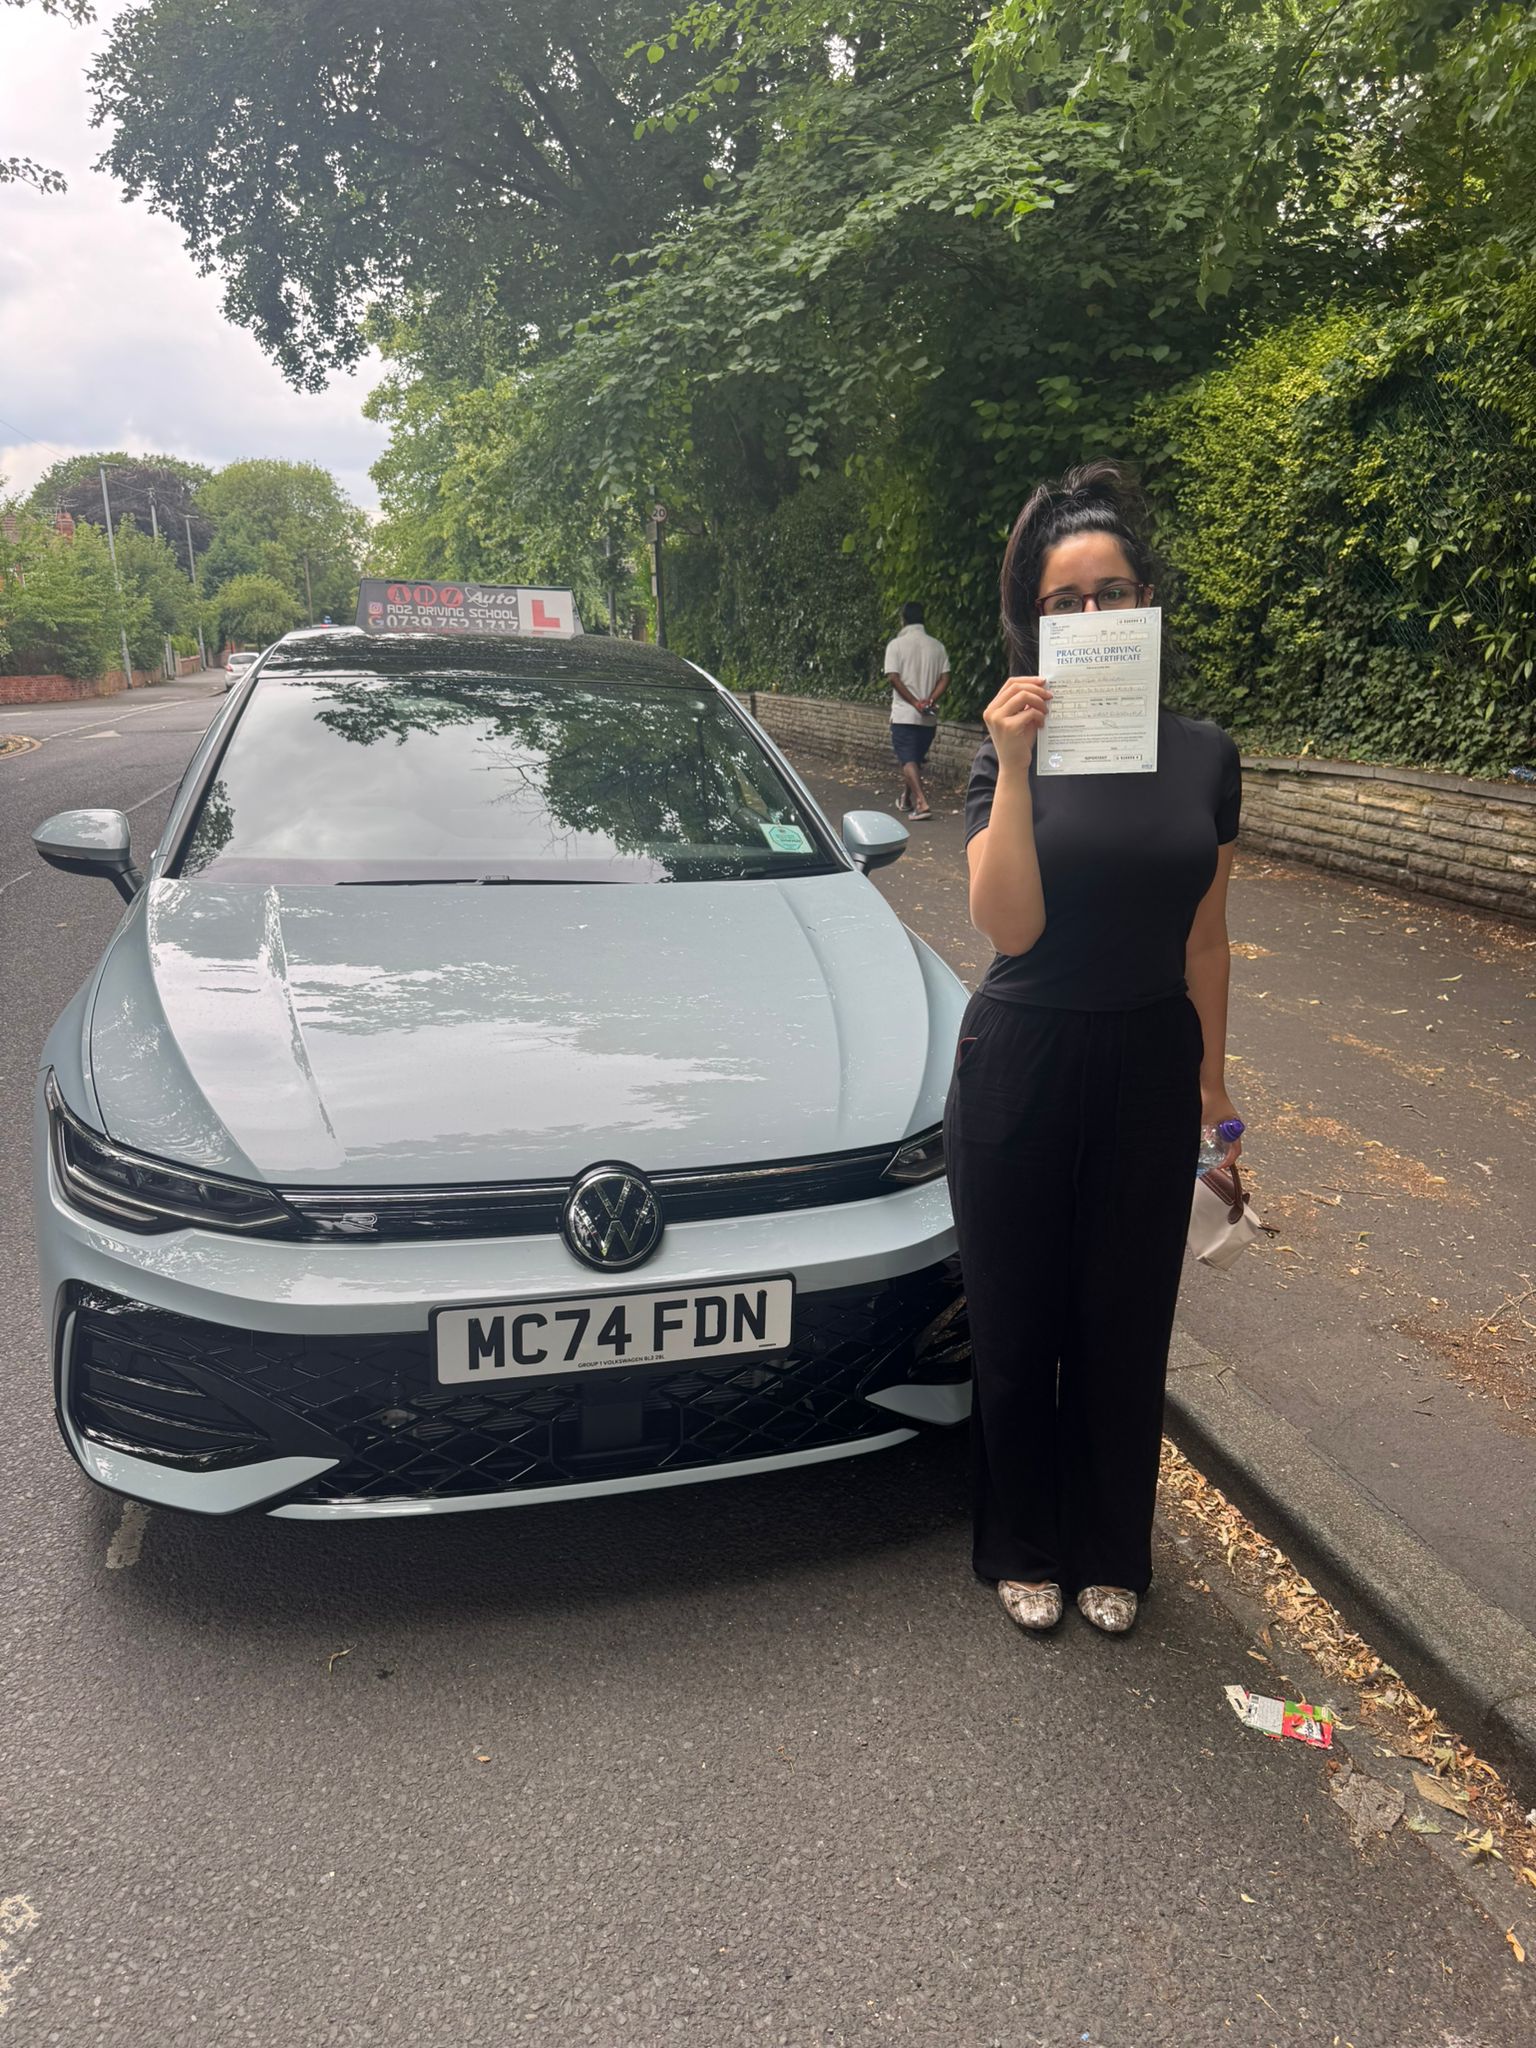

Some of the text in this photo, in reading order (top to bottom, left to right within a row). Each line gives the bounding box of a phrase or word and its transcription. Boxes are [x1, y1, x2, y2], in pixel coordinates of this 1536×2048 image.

[652, 509, 665, 517] 20
[466, 588, 517, 607] Auto
[387, 604, 518, 621] ADZ DRIVING SCHOOL
[532, 599, 561, 628] L
[386, 615, 518, 629] 0739 752 1717
[1056, 645, 1142, 657] PRACTICAL DRIVING
[1057, 653, 1141, 665] TEST PASS CERTIFICATE
[468, 1289, 768, 1370] MC74 FDN
[603, 1357, 643, 1366] VOLKSWAGEN
